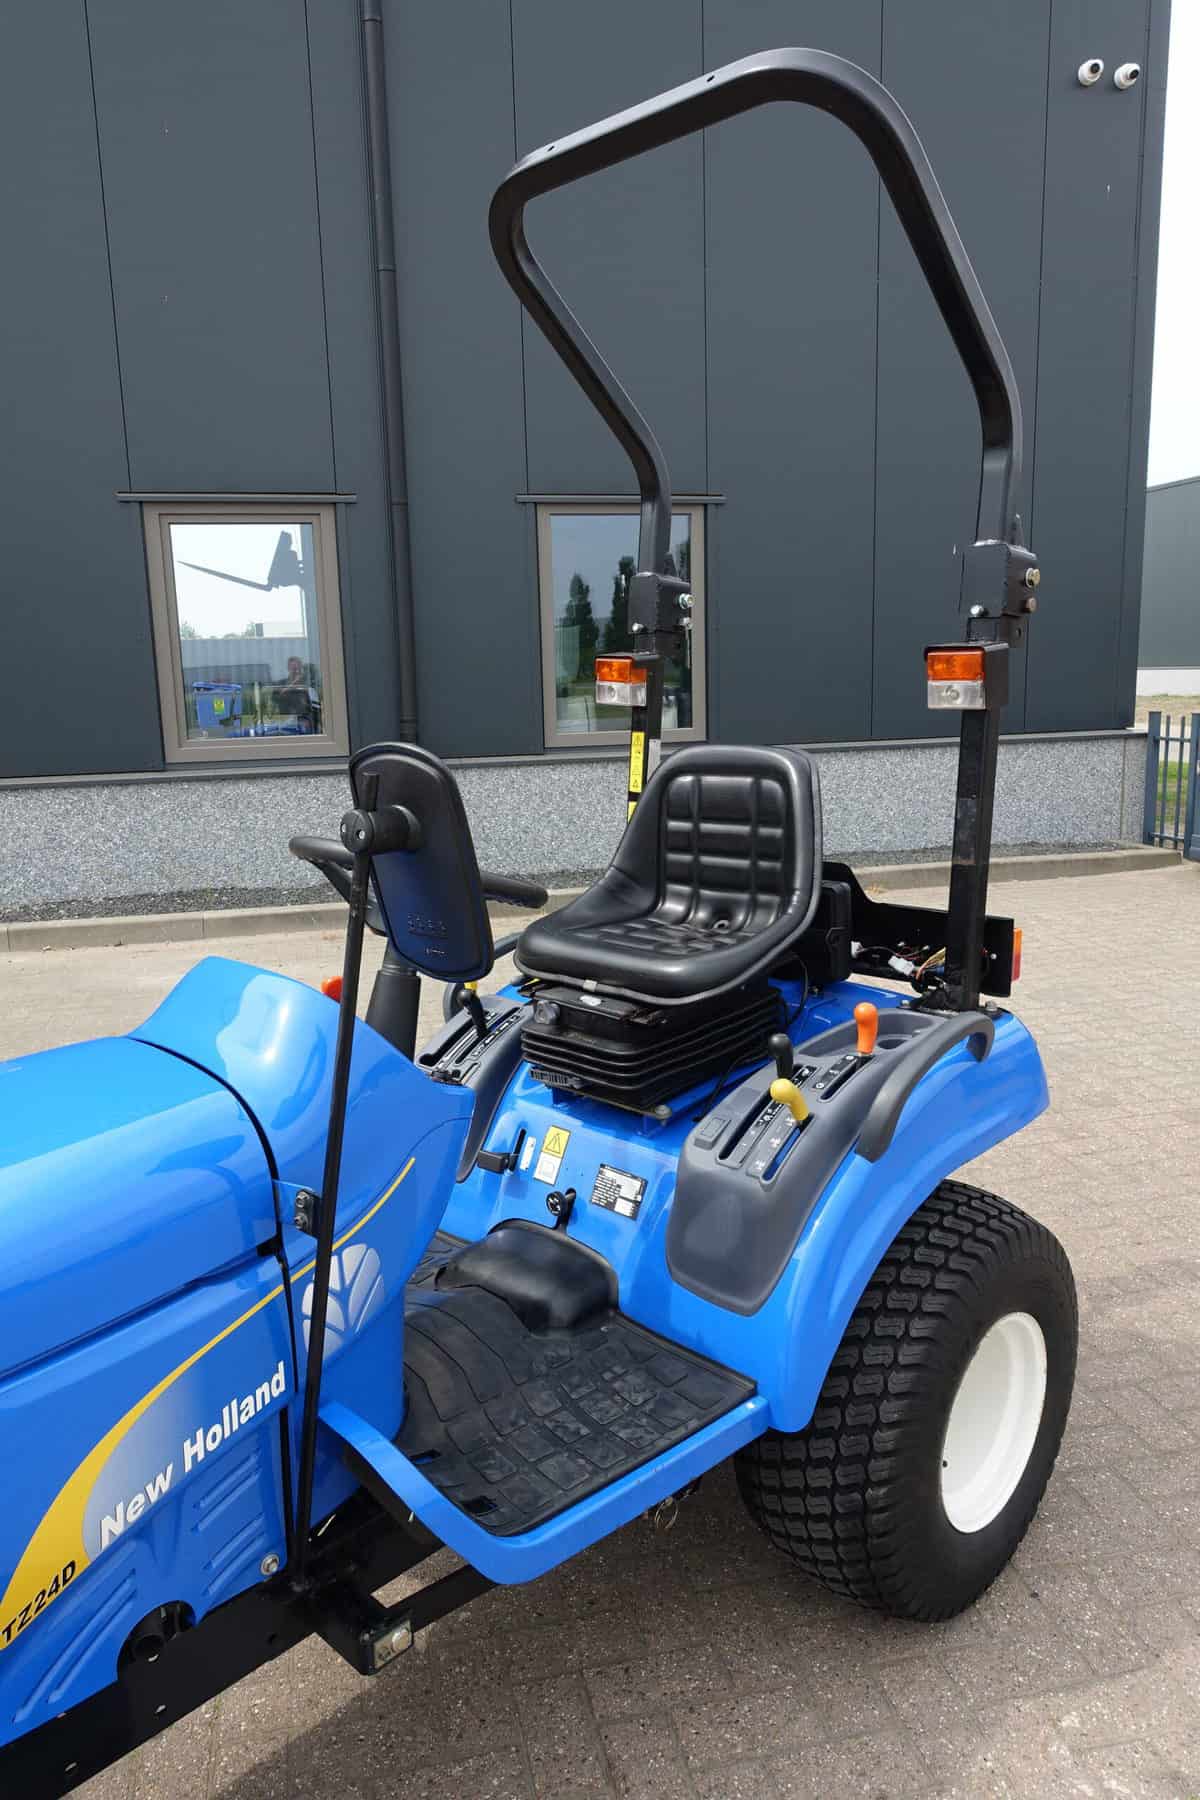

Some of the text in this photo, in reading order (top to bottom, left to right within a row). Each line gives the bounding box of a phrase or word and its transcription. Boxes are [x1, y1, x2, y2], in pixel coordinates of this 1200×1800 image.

[101, 1360, 286, 1550] New Holland
[2, 1559, 77, 1643] TZ24D
